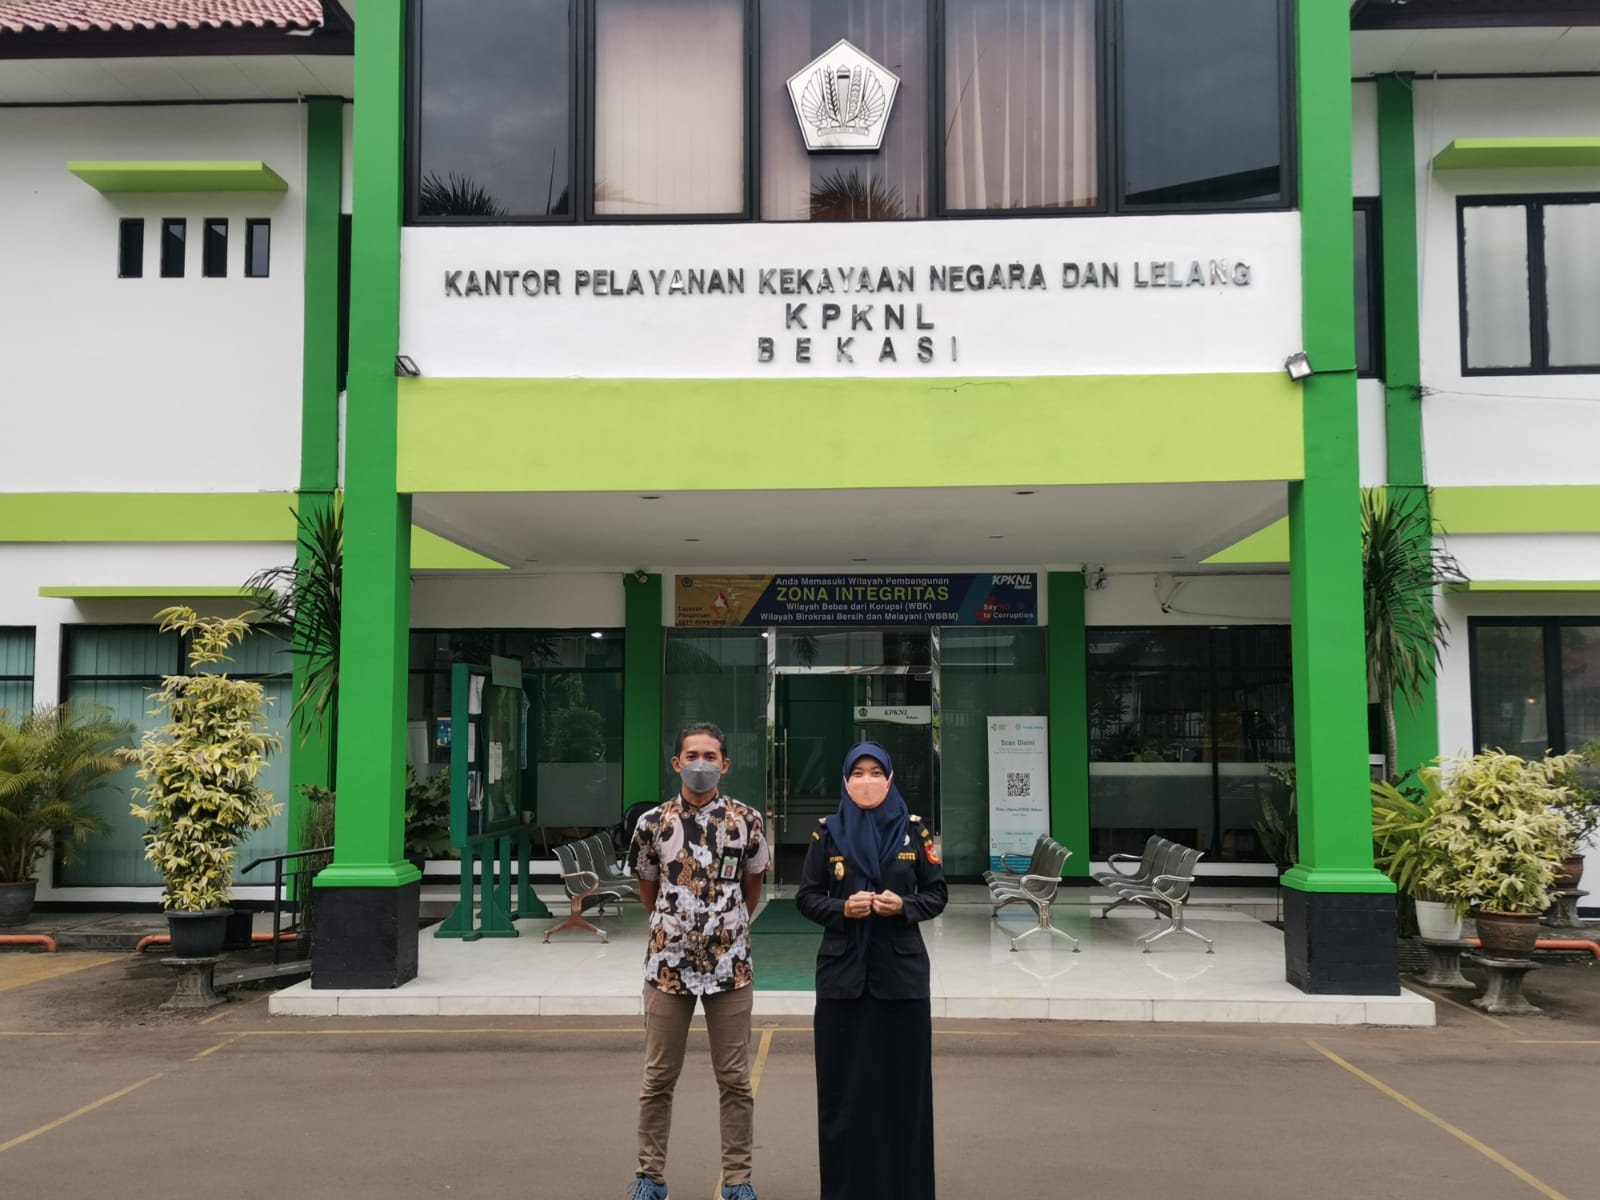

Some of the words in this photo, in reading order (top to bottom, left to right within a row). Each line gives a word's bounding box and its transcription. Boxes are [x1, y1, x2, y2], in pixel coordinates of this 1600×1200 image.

[444, 269, 561, 297] KANTOR
[575, 267, 745, 296] PELAYANAN
[758, 265, 914, 296] KEKAYAAN
[929, 262, 1047, 293] NEGARA
[1062, 261, 1119, 289] DAN
[1134, 258, 1252, 288] LELANG
[785, 302, 935, 331] KPKNL
[757, 336, 959, 363] BEKASI
[776, 577, 798, 585] Anda
[801, 577, 846, 585] Memasuki
[848, 577, 883, 586] Wilayah
[886, 577, 949, 586] Pembangunan
[992, 575, 1032, 585] KPKNL
[776, 586, 829, 601] ZONA
[836, 586, 949, 601] INTEGRITAS
[786, 602, 819, 612] Wilayah
[870, 602, 902, 612] Korupsi
[905, 602, 932, 612] (WBK)
[760, 612, 793, 622] Wilayah
[796, 612, 834, 620] Birokrasi
[836, 612, 864, 620] Bersih
[866, 612, 882, 620] dan
[884, 612, 922, 622] Melayani
[924, 612, 959, 622] (WBBM)
